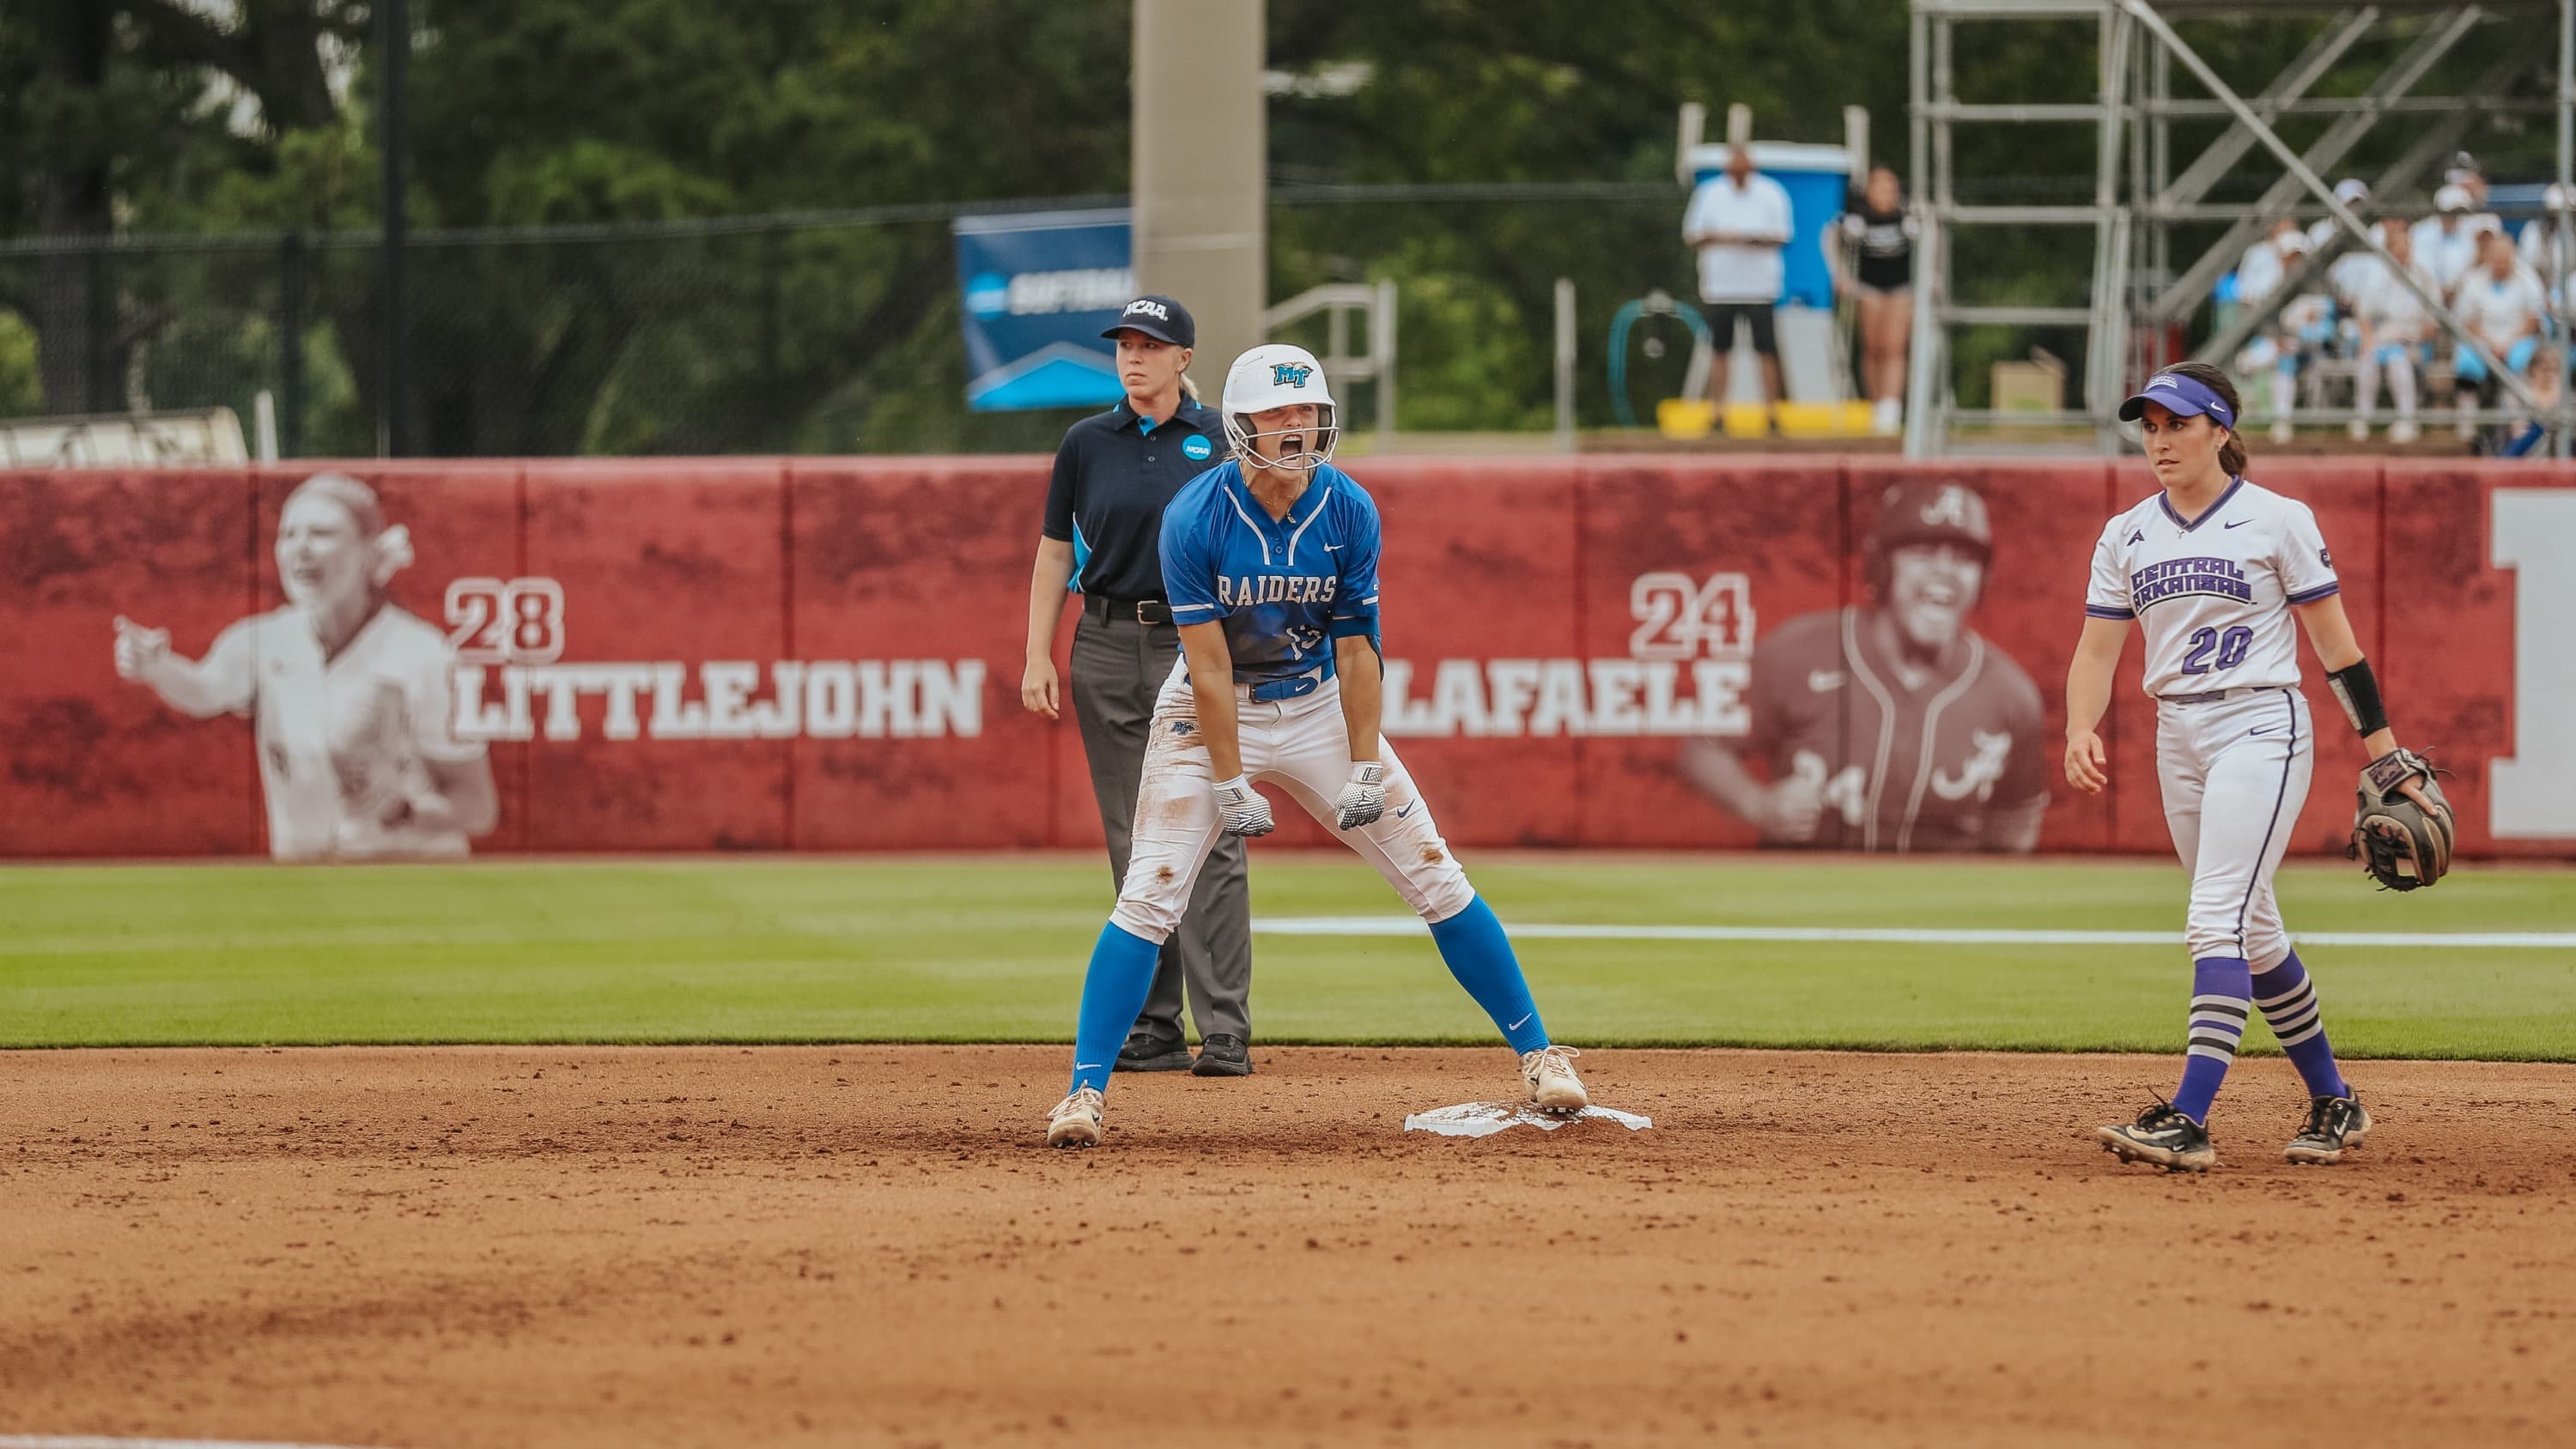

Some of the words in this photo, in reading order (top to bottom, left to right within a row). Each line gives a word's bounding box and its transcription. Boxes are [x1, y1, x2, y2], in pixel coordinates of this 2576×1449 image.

[1217, 574, 1336, 606] RAIDERS
[2131, 557, 2245, 589] CENTRAL
[2133, 574, 2252, 612] ARKANSAS
[444, 577, 565, 664] 28
[1630, 573, 1755, 659] 24
[2181, 626, 2253, 675] 20
[451, 661, 986, 741] LITTLEJOHN
[1382, 659, 1752, 737] LAFAELE
